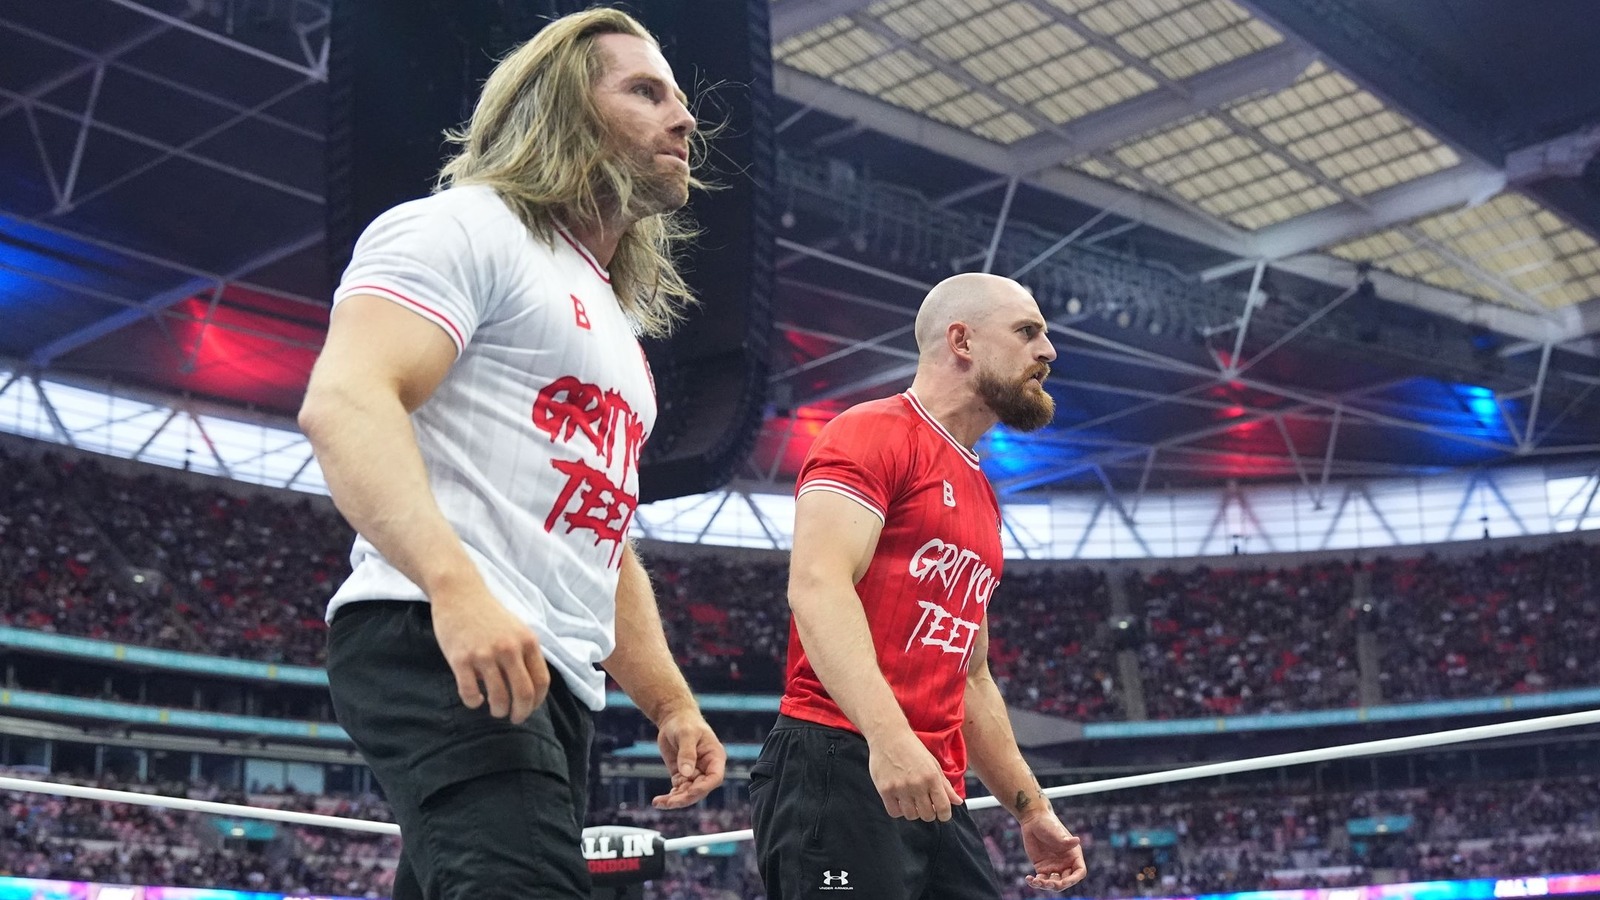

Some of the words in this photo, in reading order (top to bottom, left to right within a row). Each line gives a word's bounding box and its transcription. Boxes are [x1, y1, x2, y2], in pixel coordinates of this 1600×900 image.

[570, 294, 591, 330] B
[532, 376, 632, 470] GRIT
[543, 458, 638, 570] TEET
[943, 480, 956, 507] B
[908, 538, 981, 600] GRIT
[904, 600, 980, 673] TEET
[581, 837, 617, 860] LL
[622, 834, 654, 858] IN
[587, 858, 640, 874] ONDON
